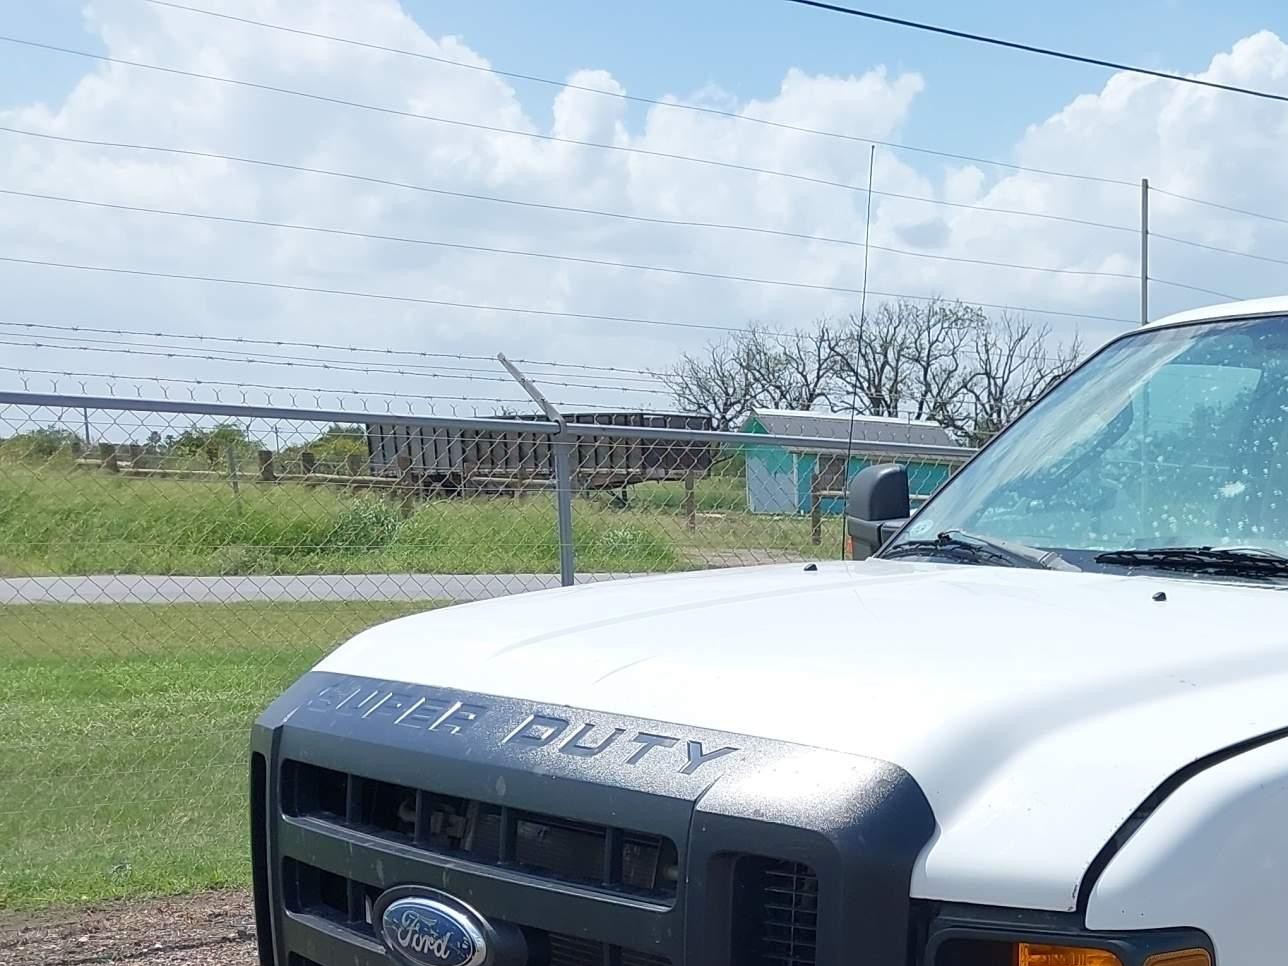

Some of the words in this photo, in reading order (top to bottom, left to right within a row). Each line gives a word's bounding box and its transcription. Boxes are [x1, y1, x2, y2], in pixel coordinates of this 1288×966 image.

[307, 687, 488, 736] SUPER
[503, 714, 740, 775] DUTY
[397, 910, 454, 960] Ford
